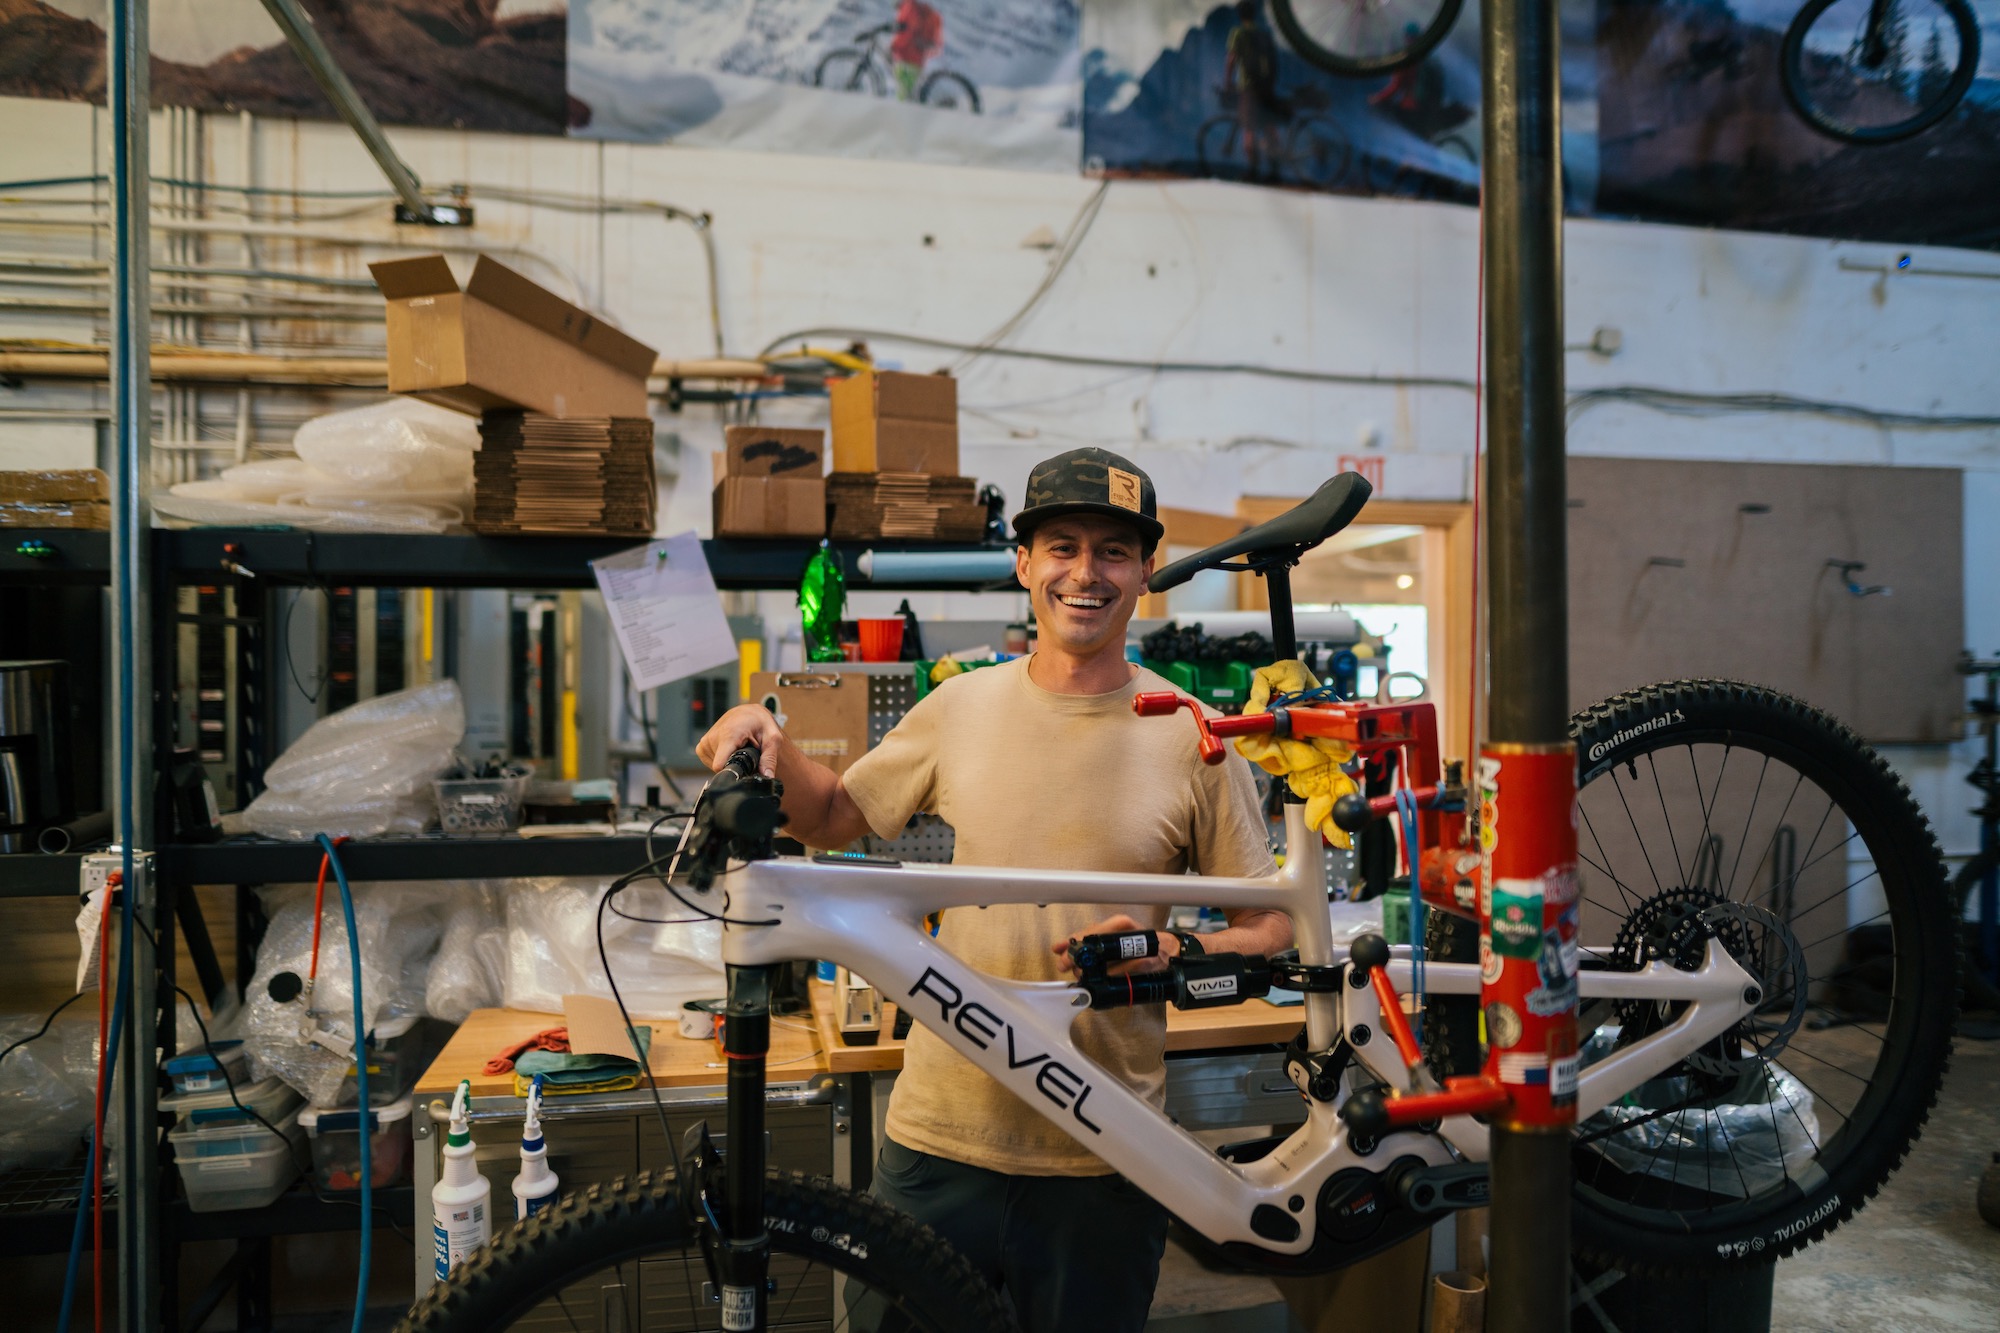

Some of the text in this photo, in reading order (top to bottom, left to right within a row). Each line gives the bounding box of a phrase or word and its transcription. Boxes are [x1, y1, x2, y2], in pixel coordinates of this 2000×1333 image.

[1589, 712, 1672, 762] Continental
[1191, 979, 1234, 992] VIVID
[908, 966, 1102, 1136] REVEL
[1774, 1195, 1841, 1242] KRYPTOTAL
[724, 1290, 753, 1309] ROCK
